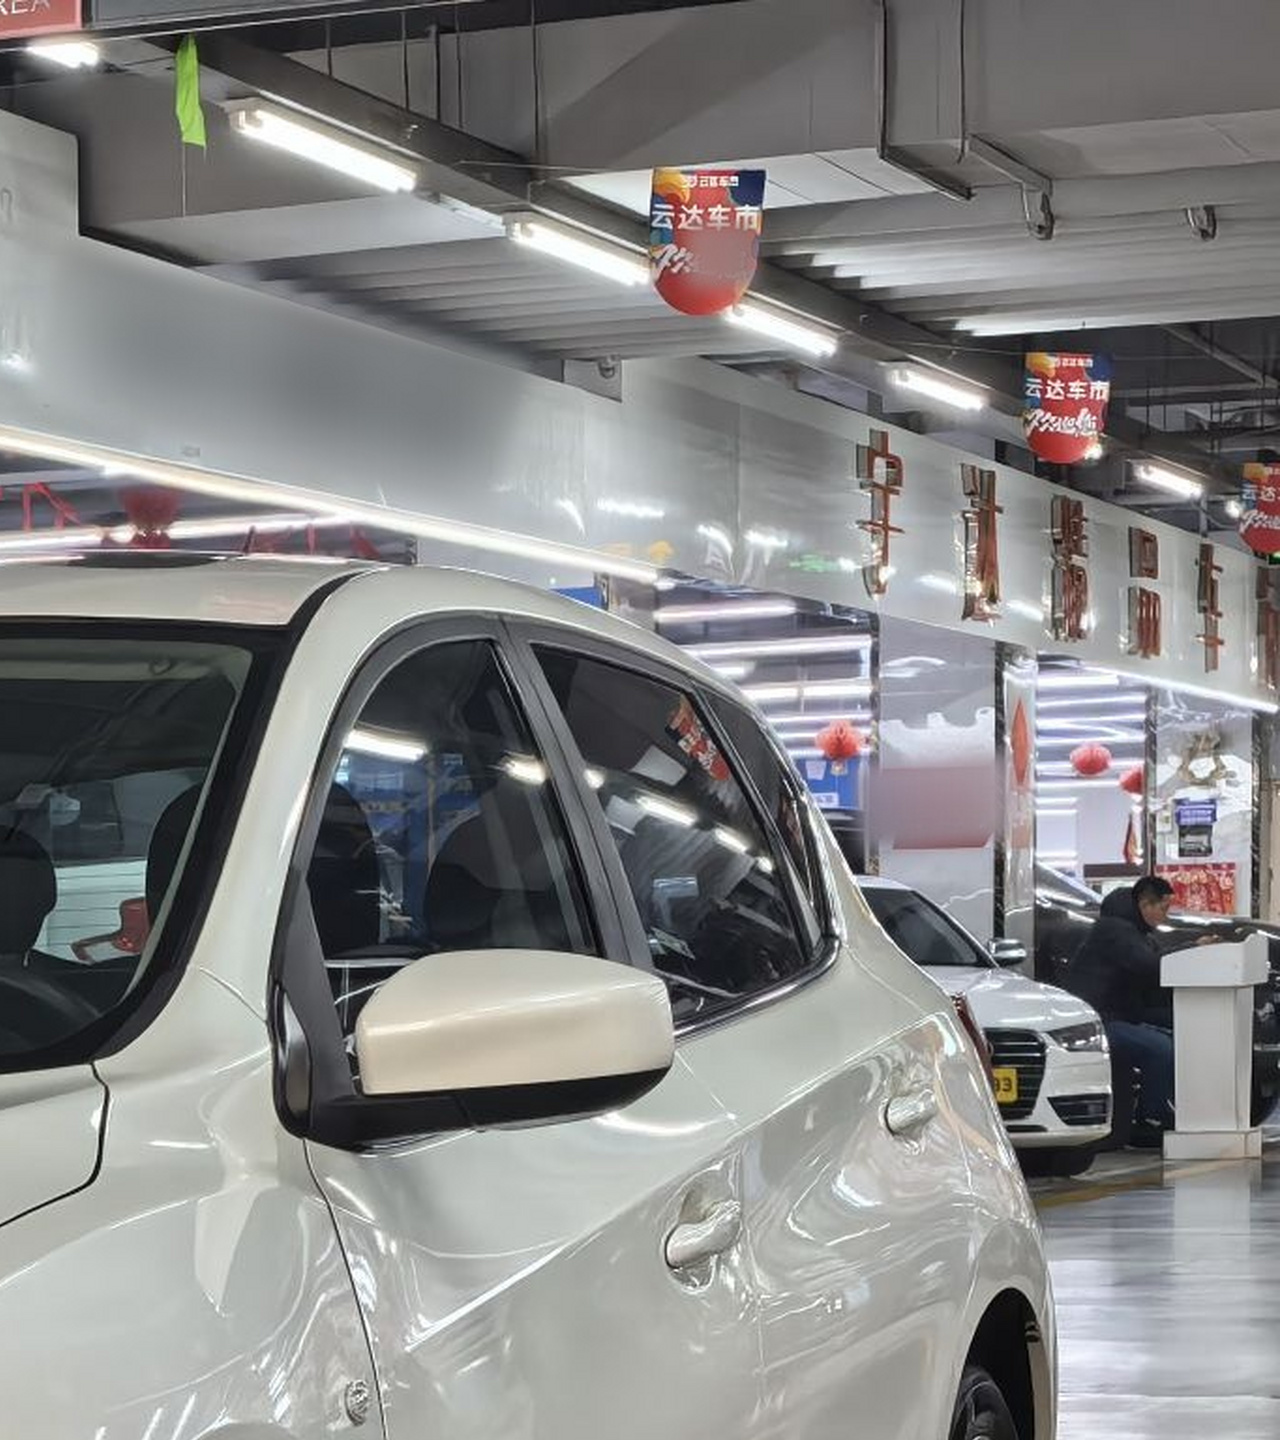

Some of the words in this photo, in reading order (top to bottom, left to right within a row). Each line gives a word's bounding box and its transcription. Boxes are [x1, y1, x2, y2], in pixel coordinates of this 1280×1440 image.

[651, 203, 760, 231] 云达车市
[1025, 378, 1110, 402] 云达车市
